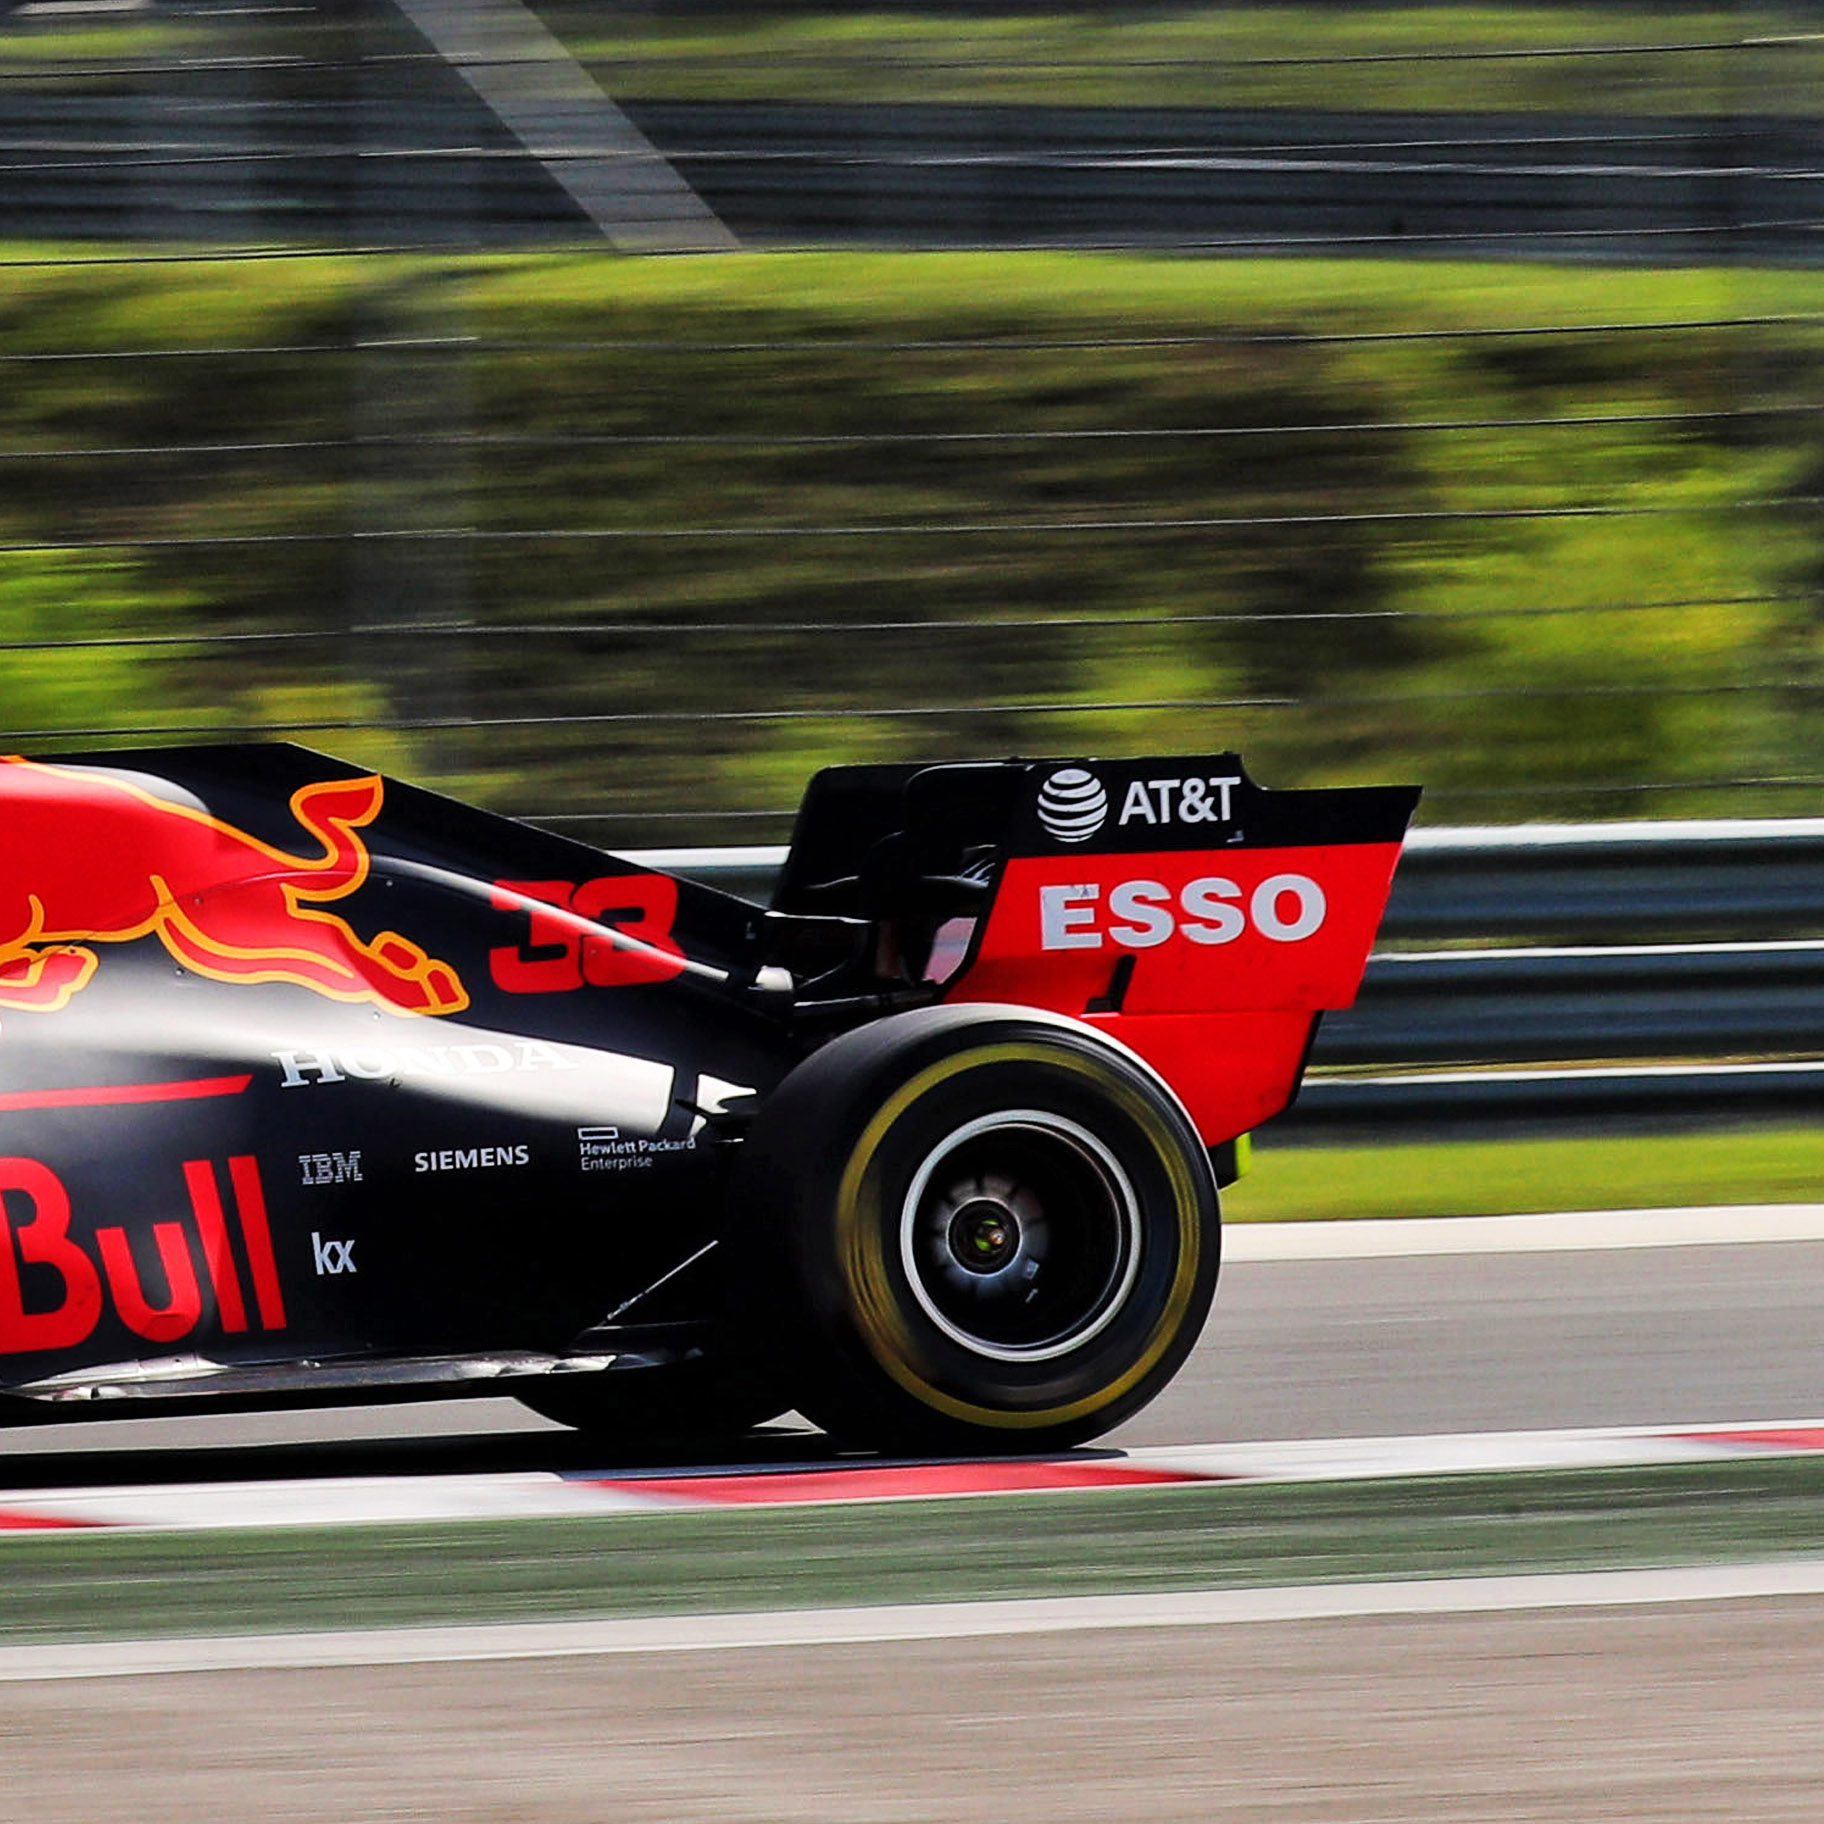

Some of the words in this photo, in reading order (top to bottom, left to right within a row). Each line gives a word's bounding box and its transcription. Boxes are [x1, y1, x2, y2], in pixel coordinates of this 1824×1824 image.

[1118, 776, 1241, 825] AT&T
[1039, 873, 1327, 950] ESSO
[271, 1041, 580, 1088] HONDA
[414, 1144, 530, 1173] SIEMENS
[579, 1140, 636, 1156] Hewlett
[638, 1136, 697, 1153] Packard
[580, 1154, 653, 1172] Enterprise
[298, 1150, 364, 1186] IBM
